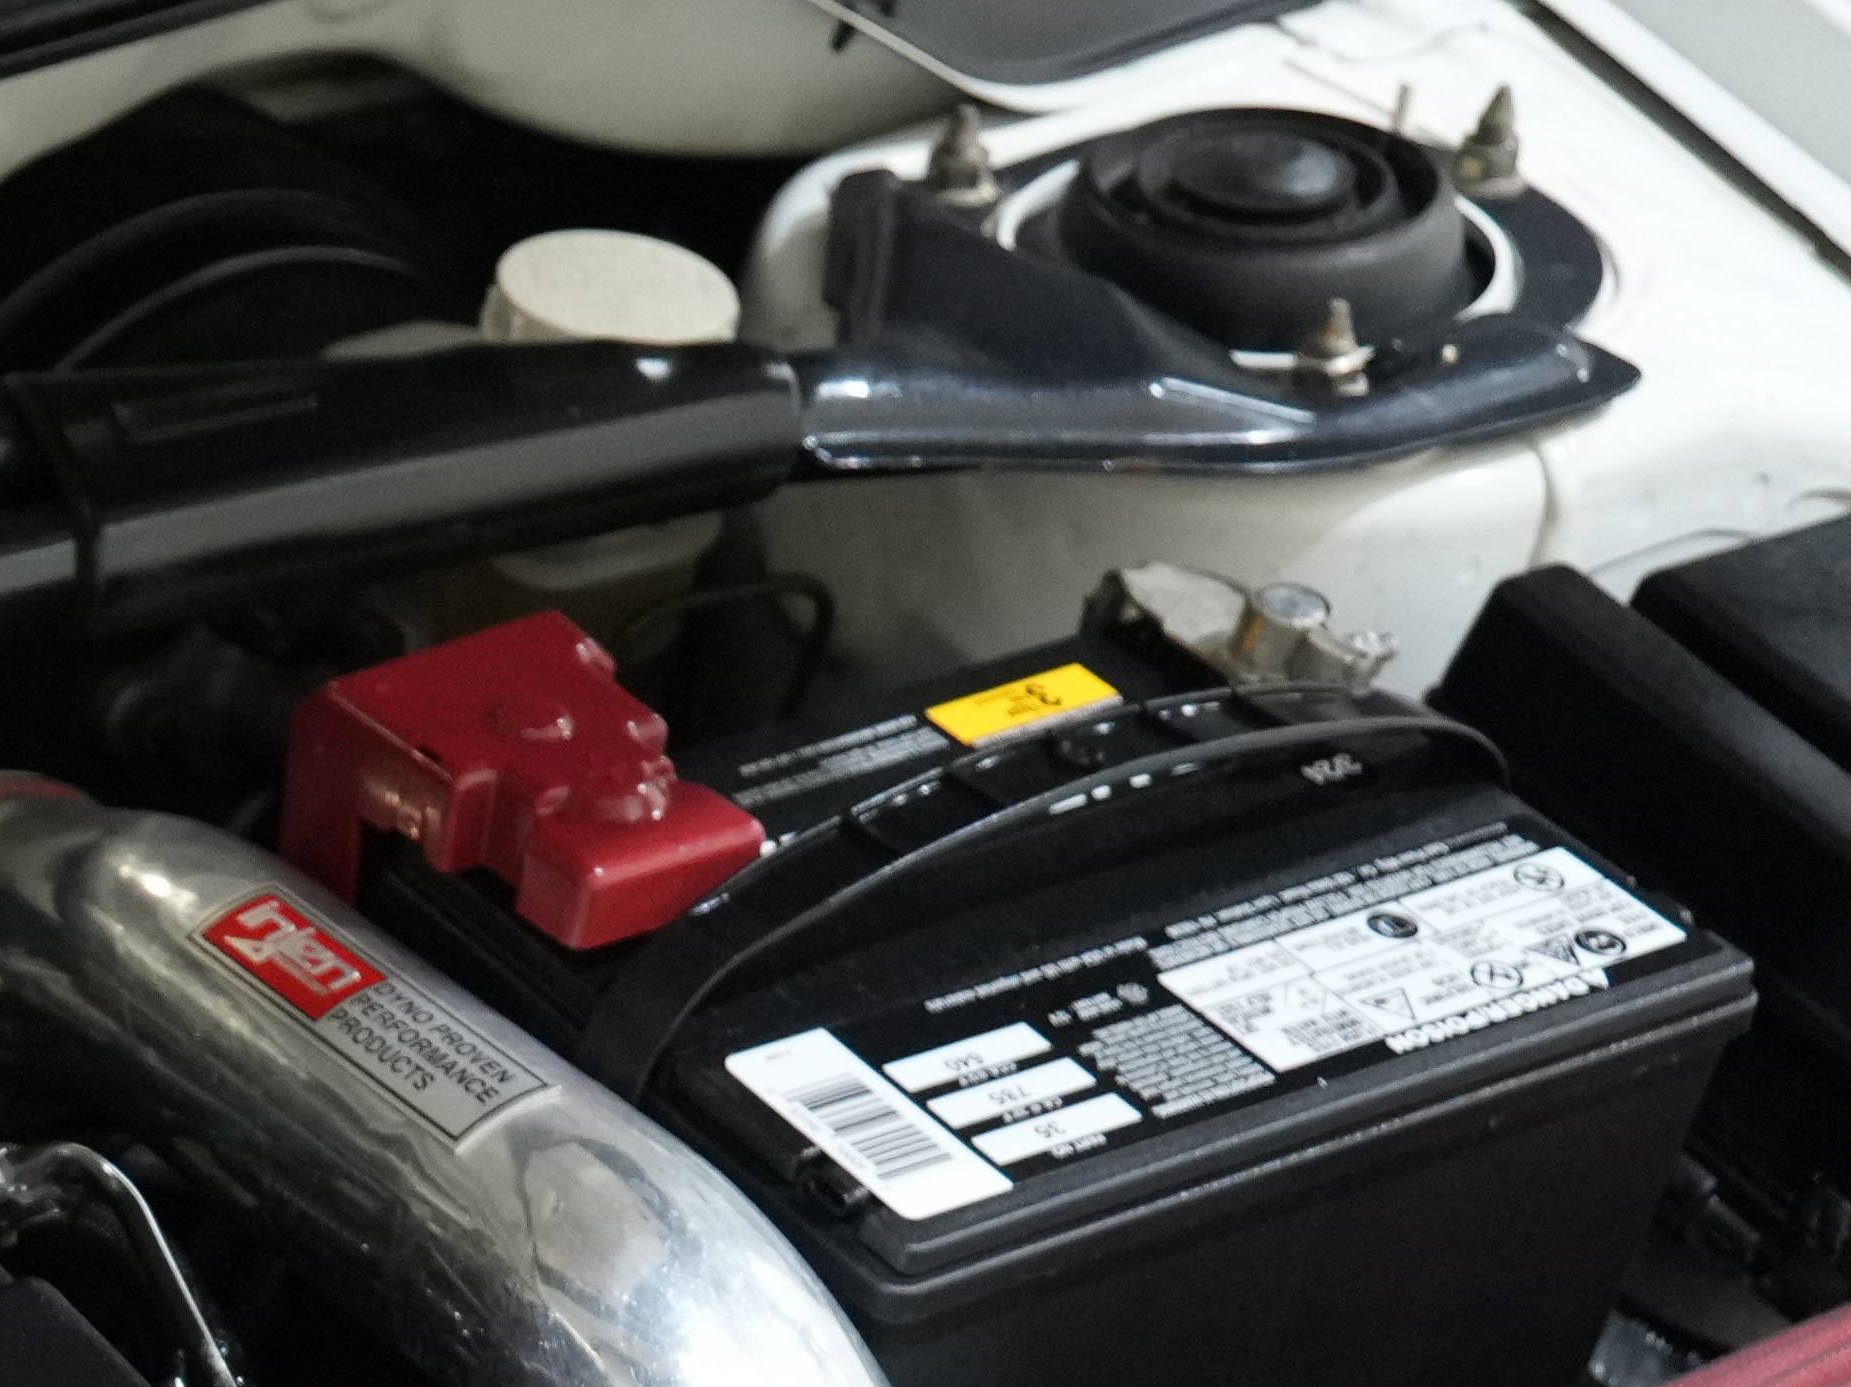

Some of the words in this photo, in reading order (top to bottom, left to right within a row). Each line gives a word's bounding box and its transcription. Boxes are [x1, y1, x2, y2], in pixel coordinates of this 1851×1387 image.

[328, 1006, 435, 1093] PRODUCTS
[350, 991, 501, 1105] PERFORMANCE
[372, 981, 434, 1025] DYNO
[430, 1024, 515, 1084] PROVEN
